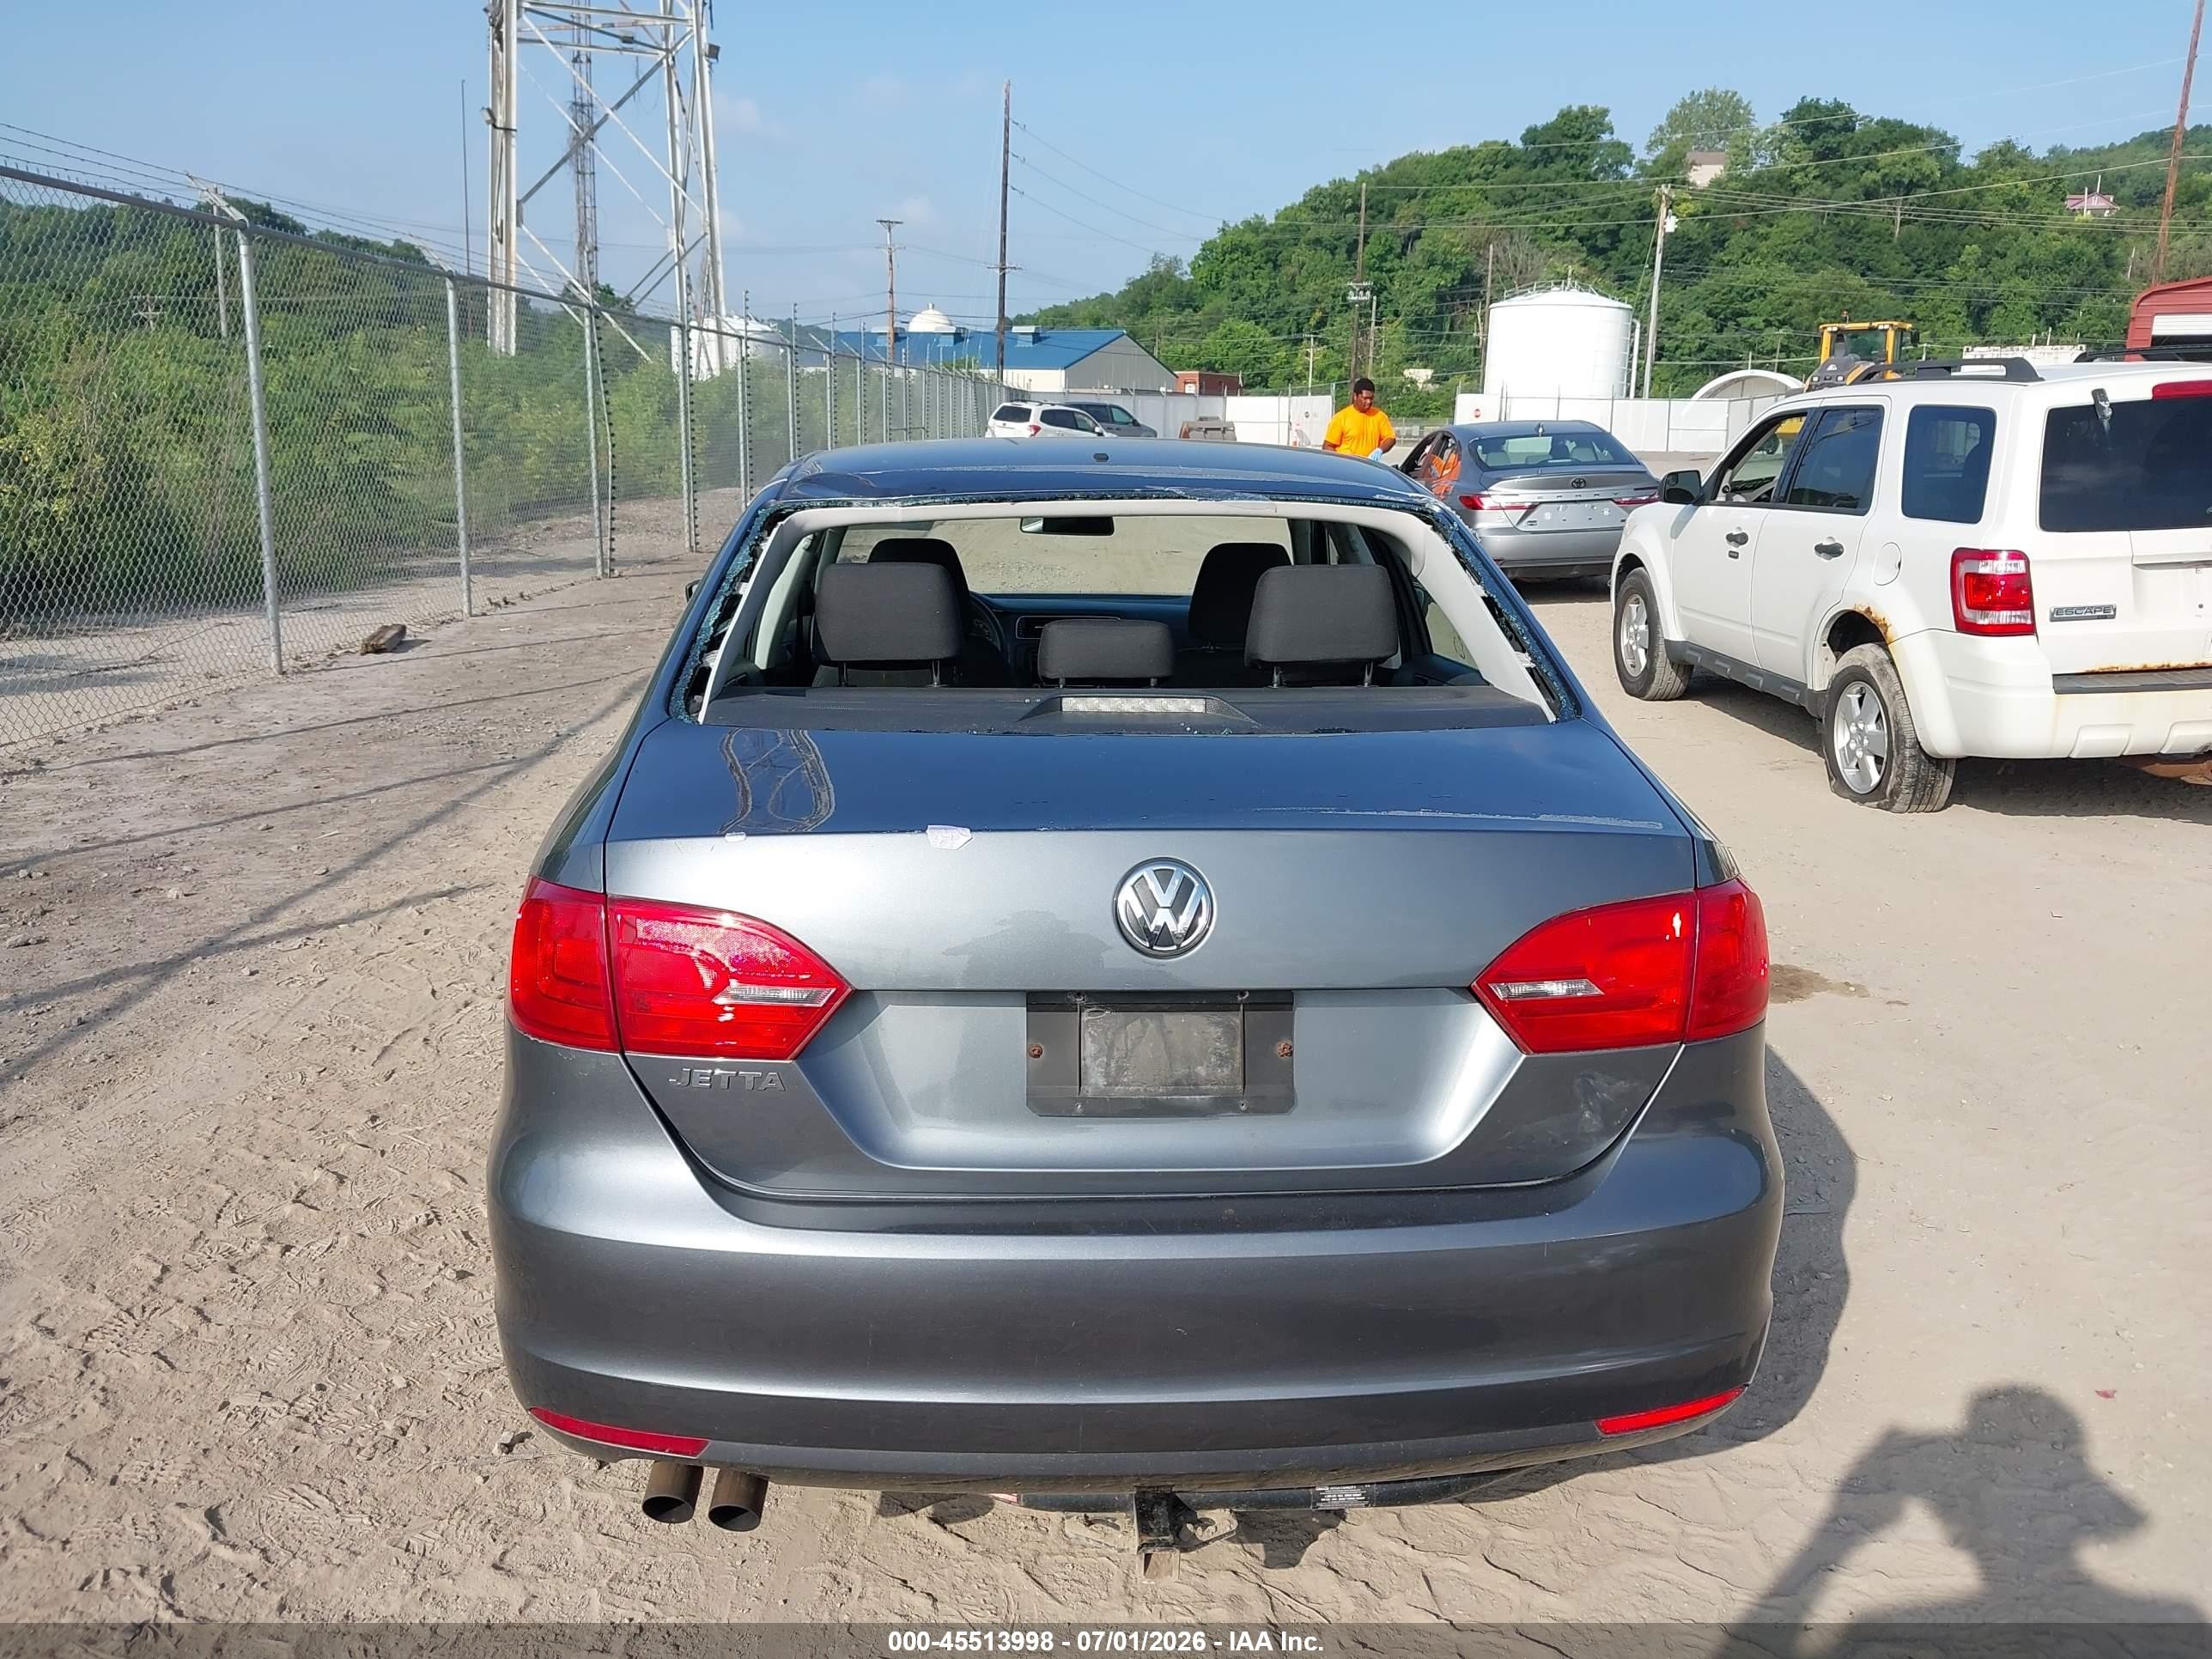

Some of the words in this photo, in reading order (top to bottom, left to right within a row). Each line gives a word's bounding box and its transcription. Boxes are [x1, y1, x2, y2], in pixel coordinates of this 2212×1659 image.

[2055, 605, 2112, 617] ESCAPE
[1117, 861, 1212, 955] VW
[668, 1067, 787, 1091] JETTA
